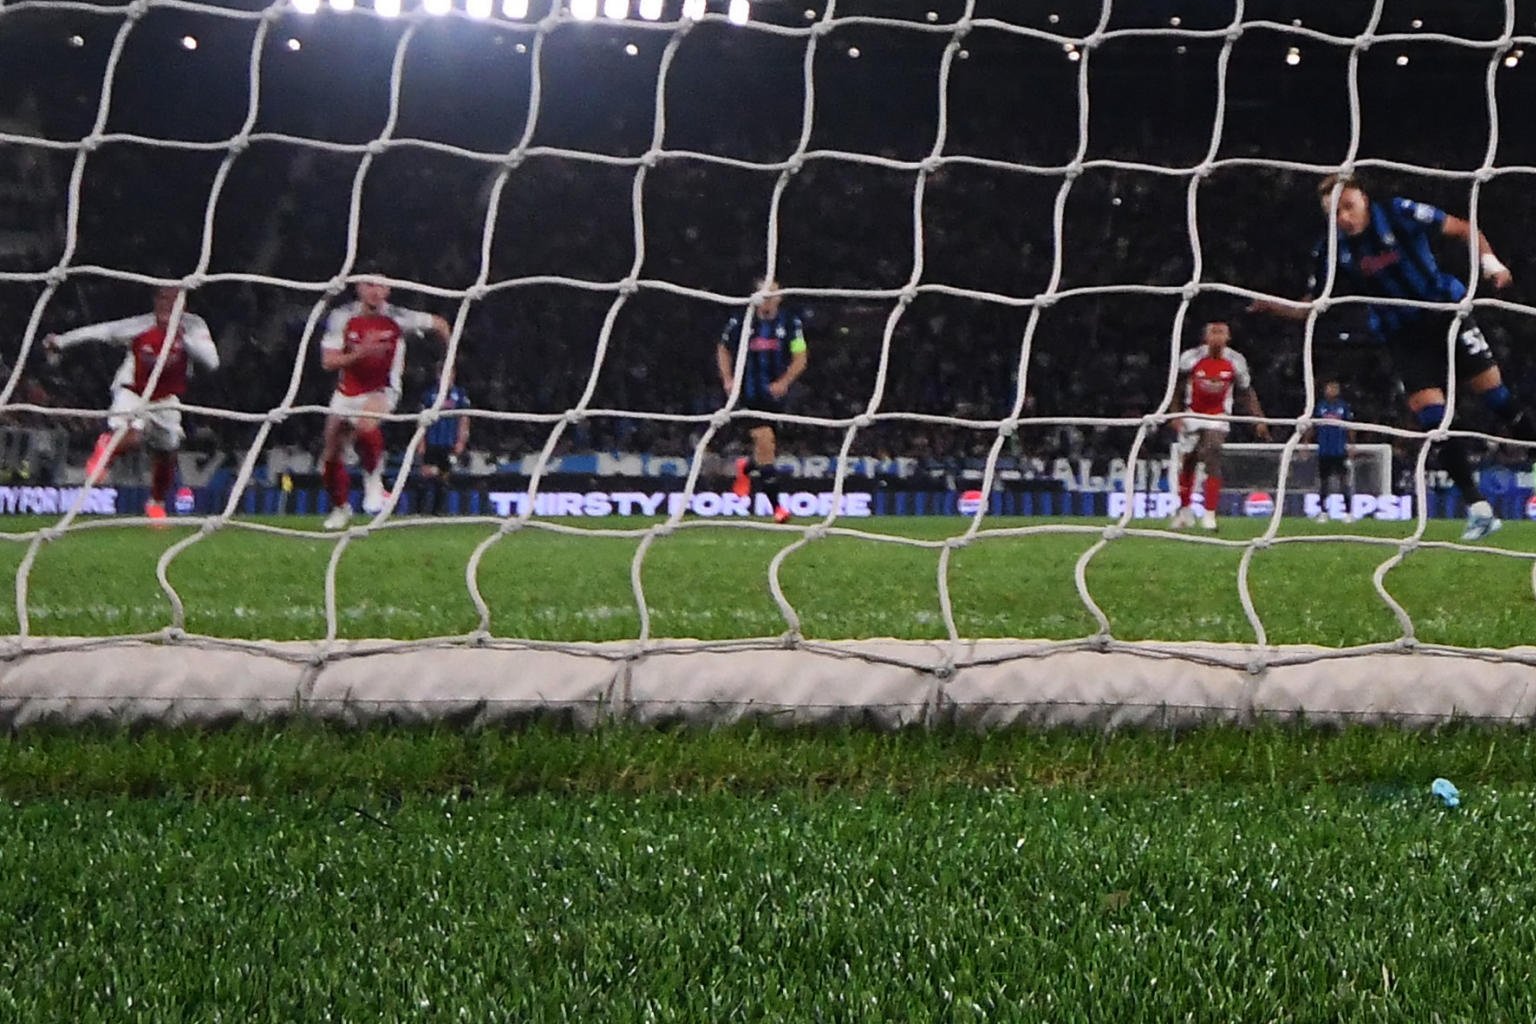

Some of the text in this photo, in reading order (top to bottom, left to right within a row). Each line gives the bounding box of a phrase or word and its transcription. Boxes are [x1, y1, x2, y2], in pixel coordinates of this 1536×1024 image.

[489, 492, 872, 517] THIRSTY FOR MORE
[1107, 491, 1206, 518] PEPS
[1304, 493, 1413, 520] PEPSI
